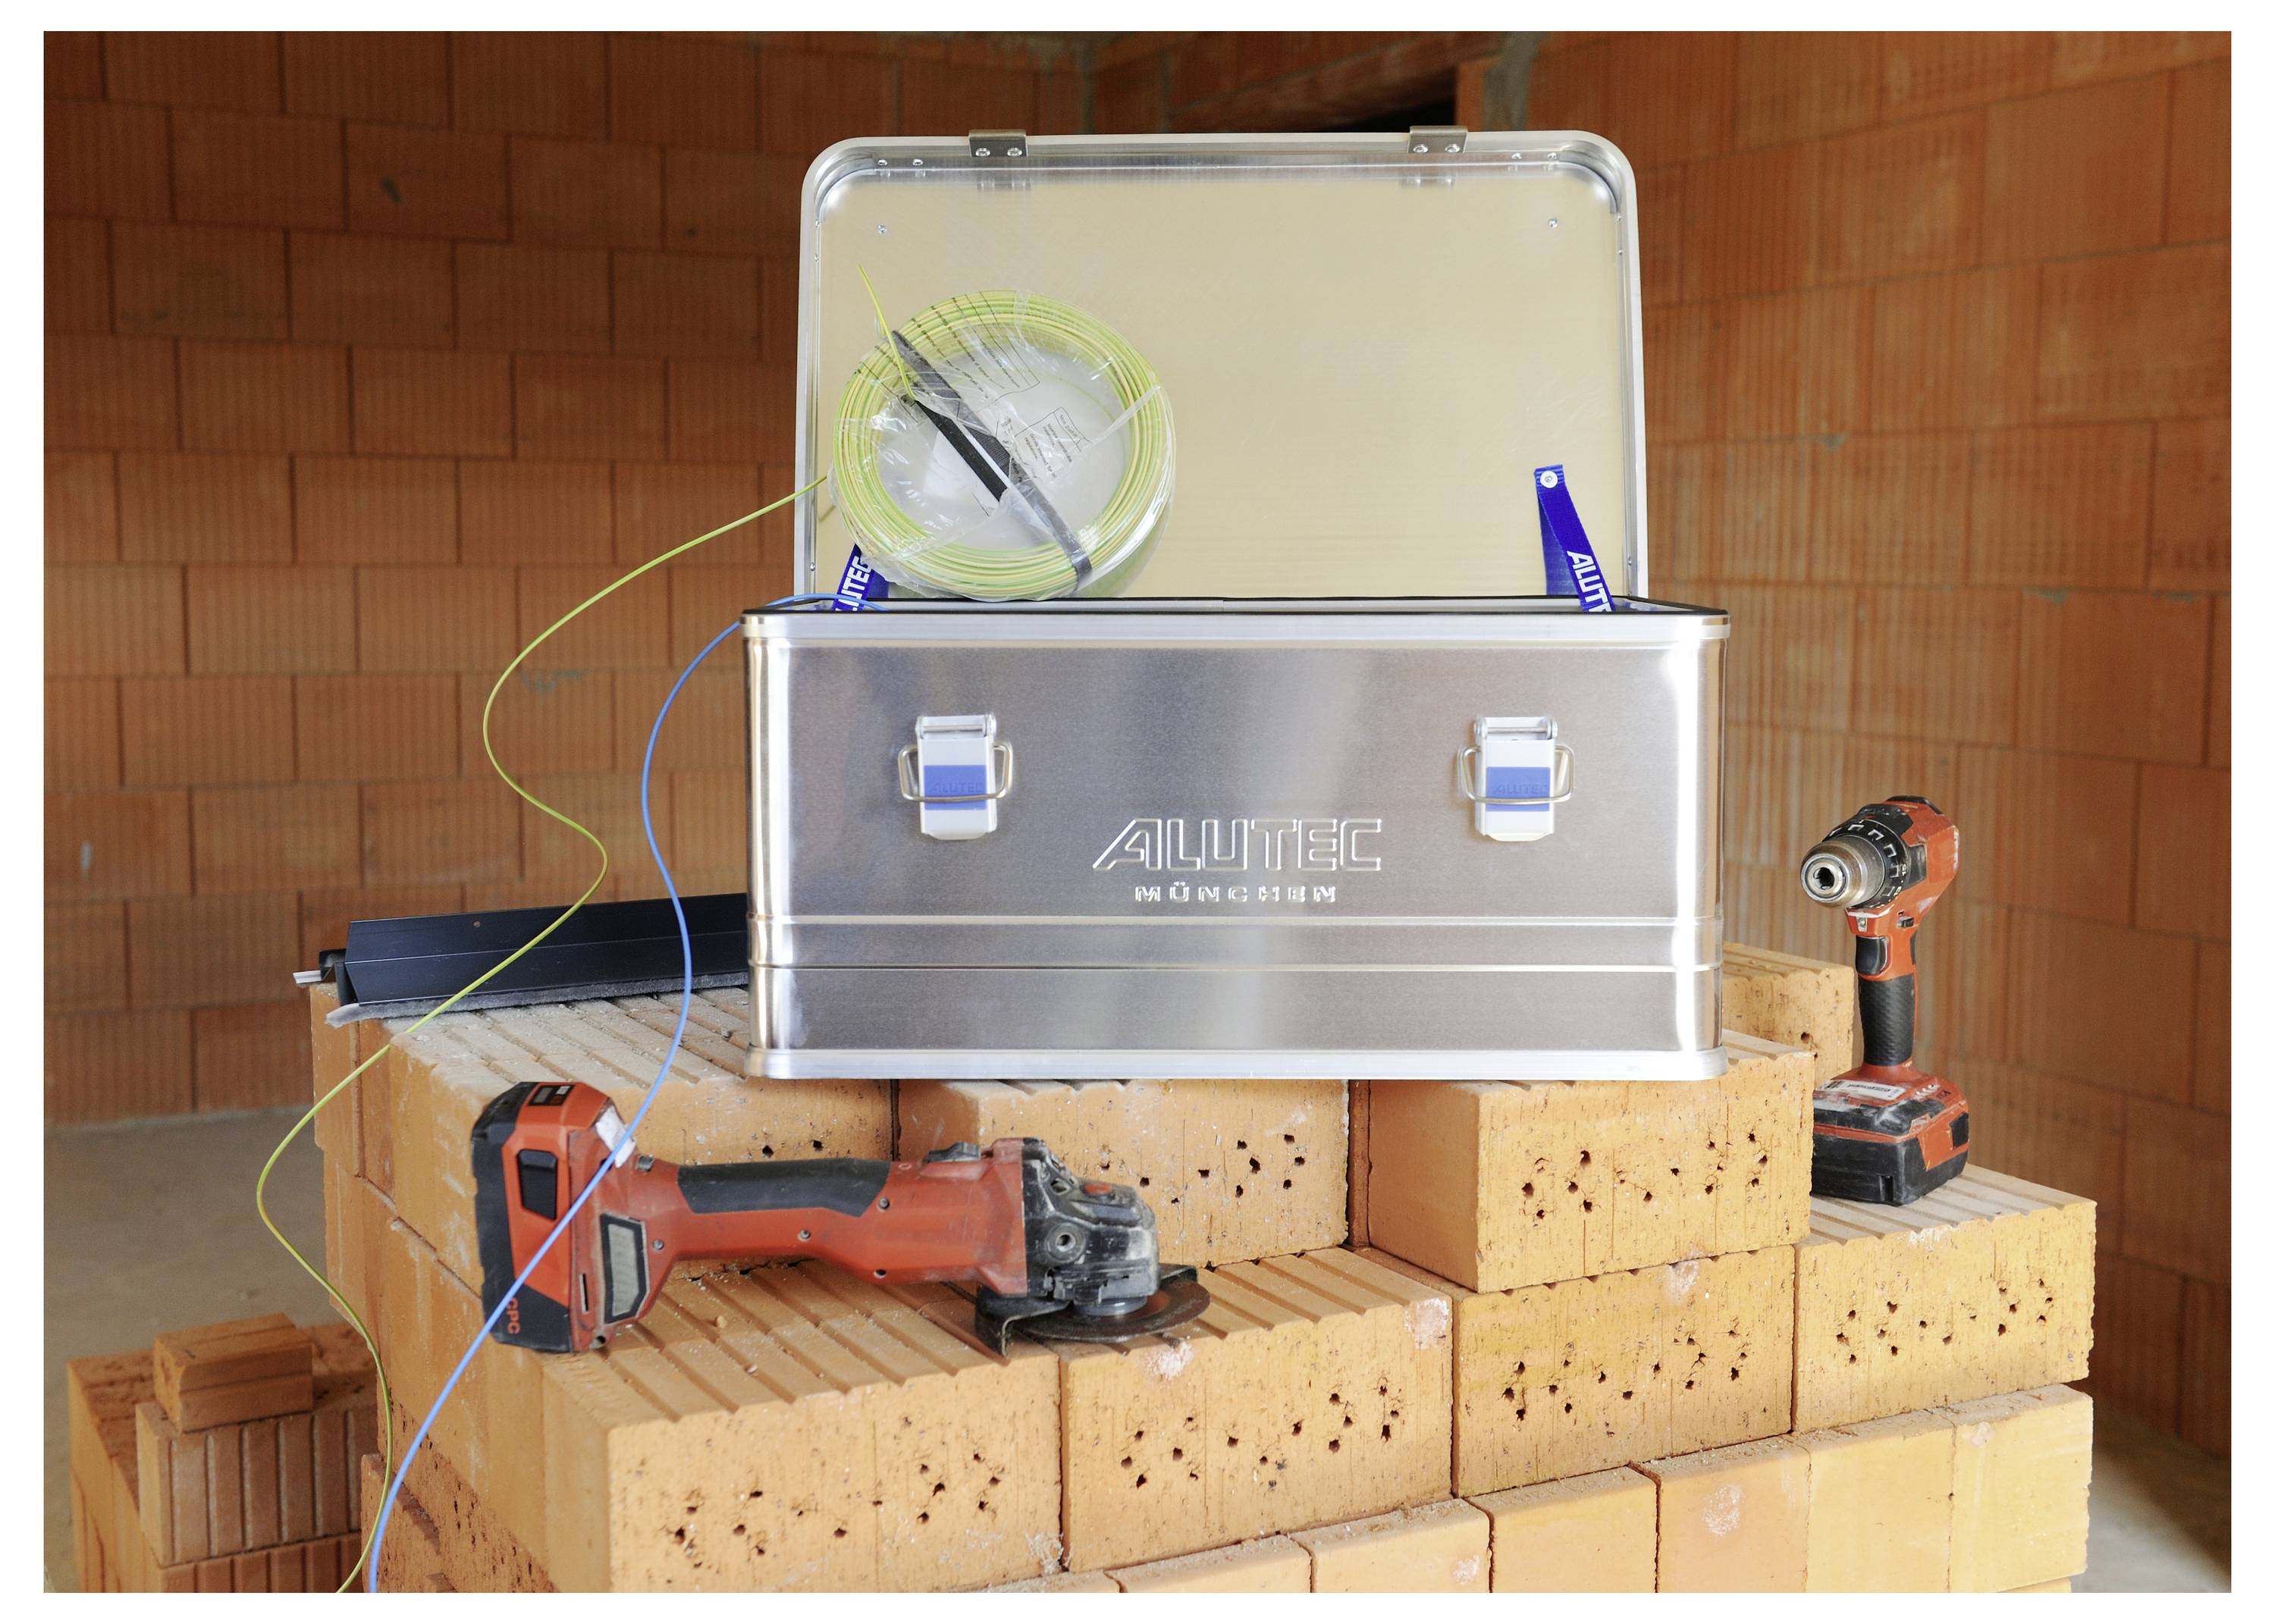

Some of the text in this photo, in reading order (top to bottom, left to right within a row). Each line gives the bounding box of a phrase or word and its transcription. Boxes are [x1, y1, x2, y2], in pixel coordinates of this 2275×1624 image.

[835, 555, 872, 611] UTEC
[1092, 818, 1382, 871] ALUTEC
[1134, 881, 1336, 903] MÜNCHEN
